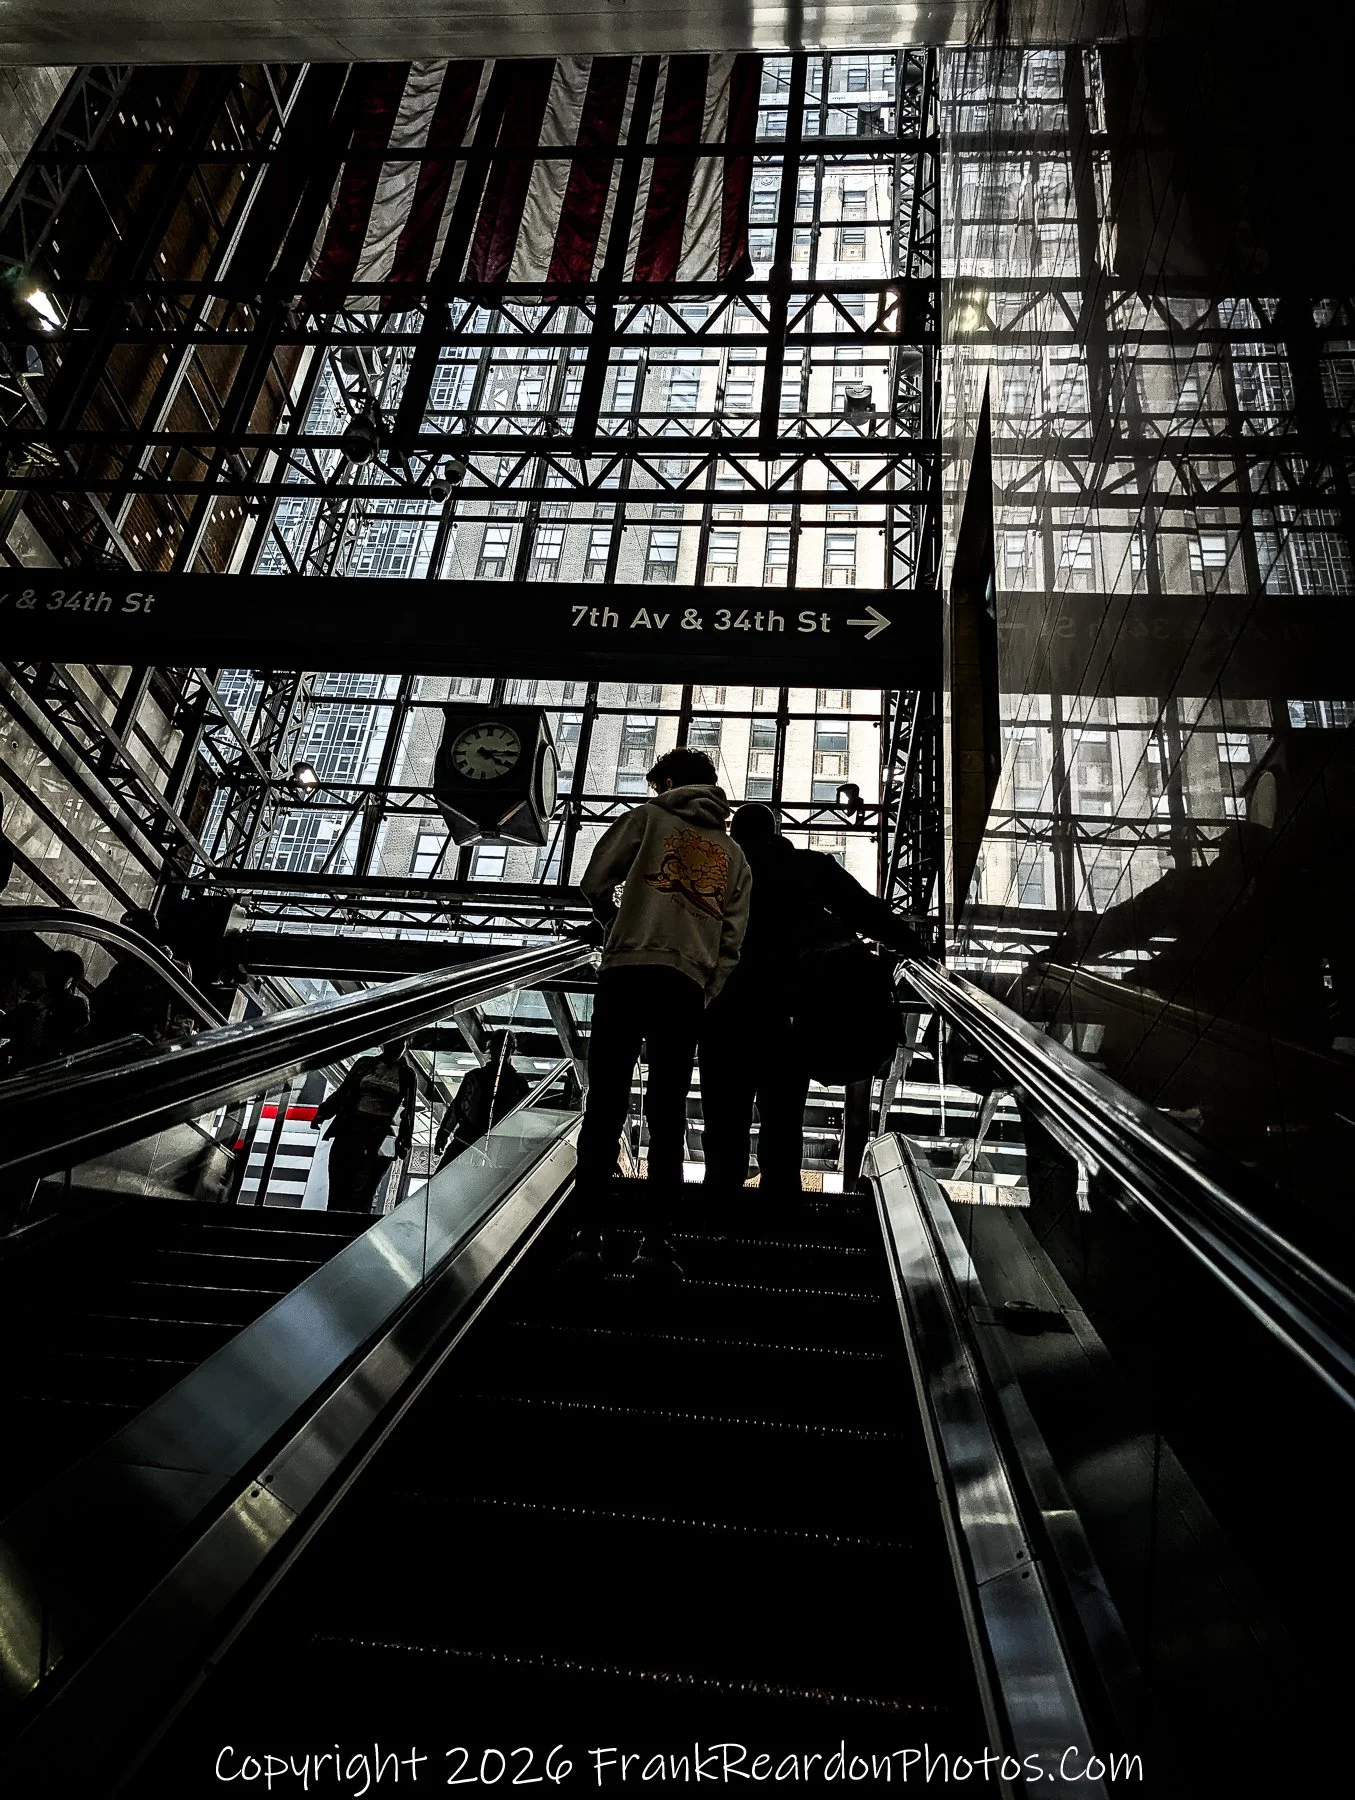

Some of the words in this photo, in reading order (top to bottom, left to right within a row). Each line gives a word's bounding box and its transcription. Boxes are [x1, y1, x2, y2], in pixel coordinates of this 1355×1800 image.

[15, 588, 38, 610] &
[46, 589, 113, 612] 34th
[121, 592, 156, 613] St
[571, 605, 620, 628] 7th
[630, 607, 671, 629] Av
[680, 608, 704, 630] &
[713, 608, 785, 632] 34th
[797, 610, 831, 633] St
